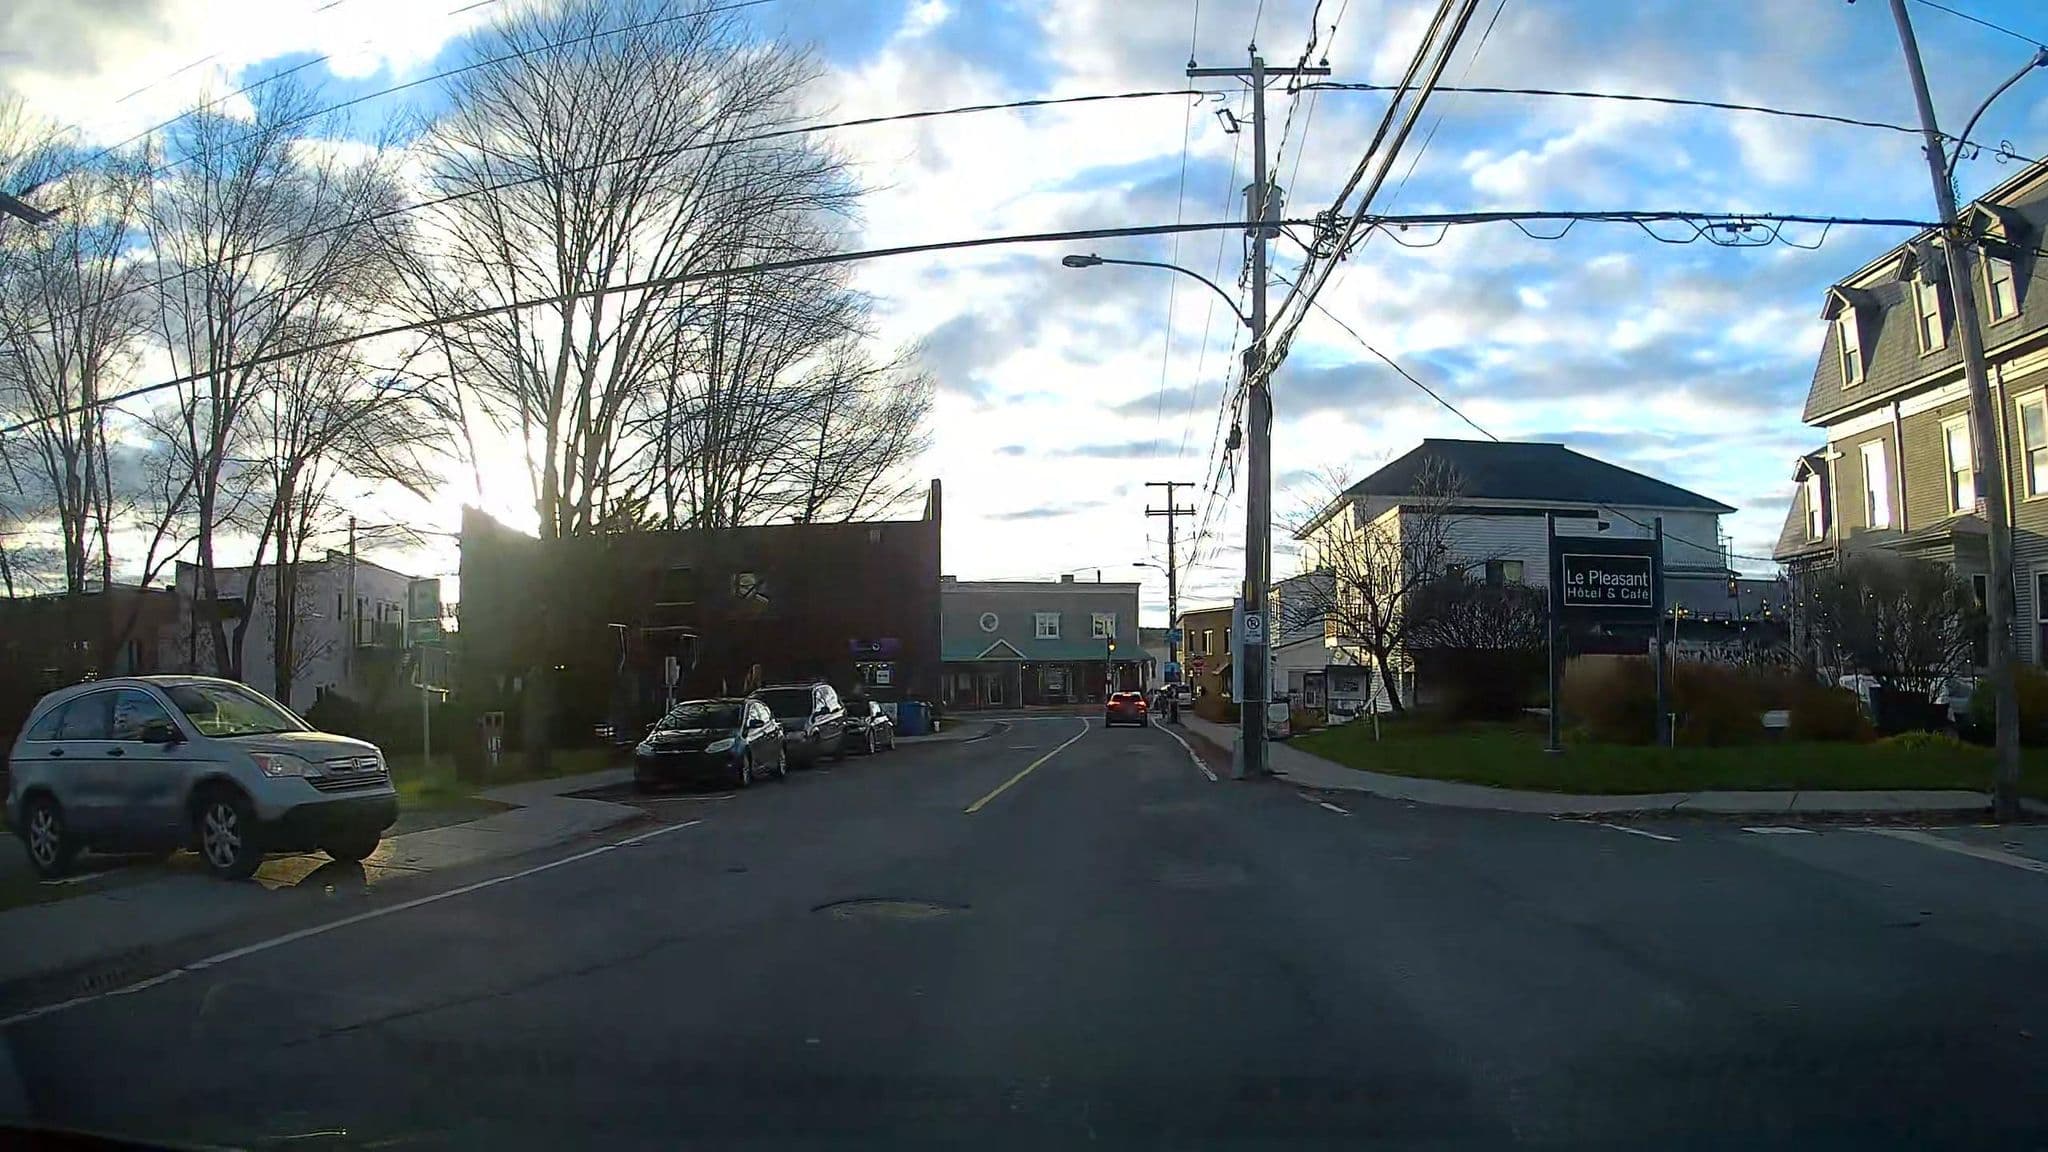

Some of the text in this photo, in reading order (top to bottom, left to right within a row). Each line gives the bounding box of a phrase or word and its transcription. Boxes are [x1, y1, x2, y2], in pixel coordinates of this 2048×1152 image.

[1567, 569, 1649, 587] Le Pleasant
[1567, 586, 1649, 600] Hôtel & Café
